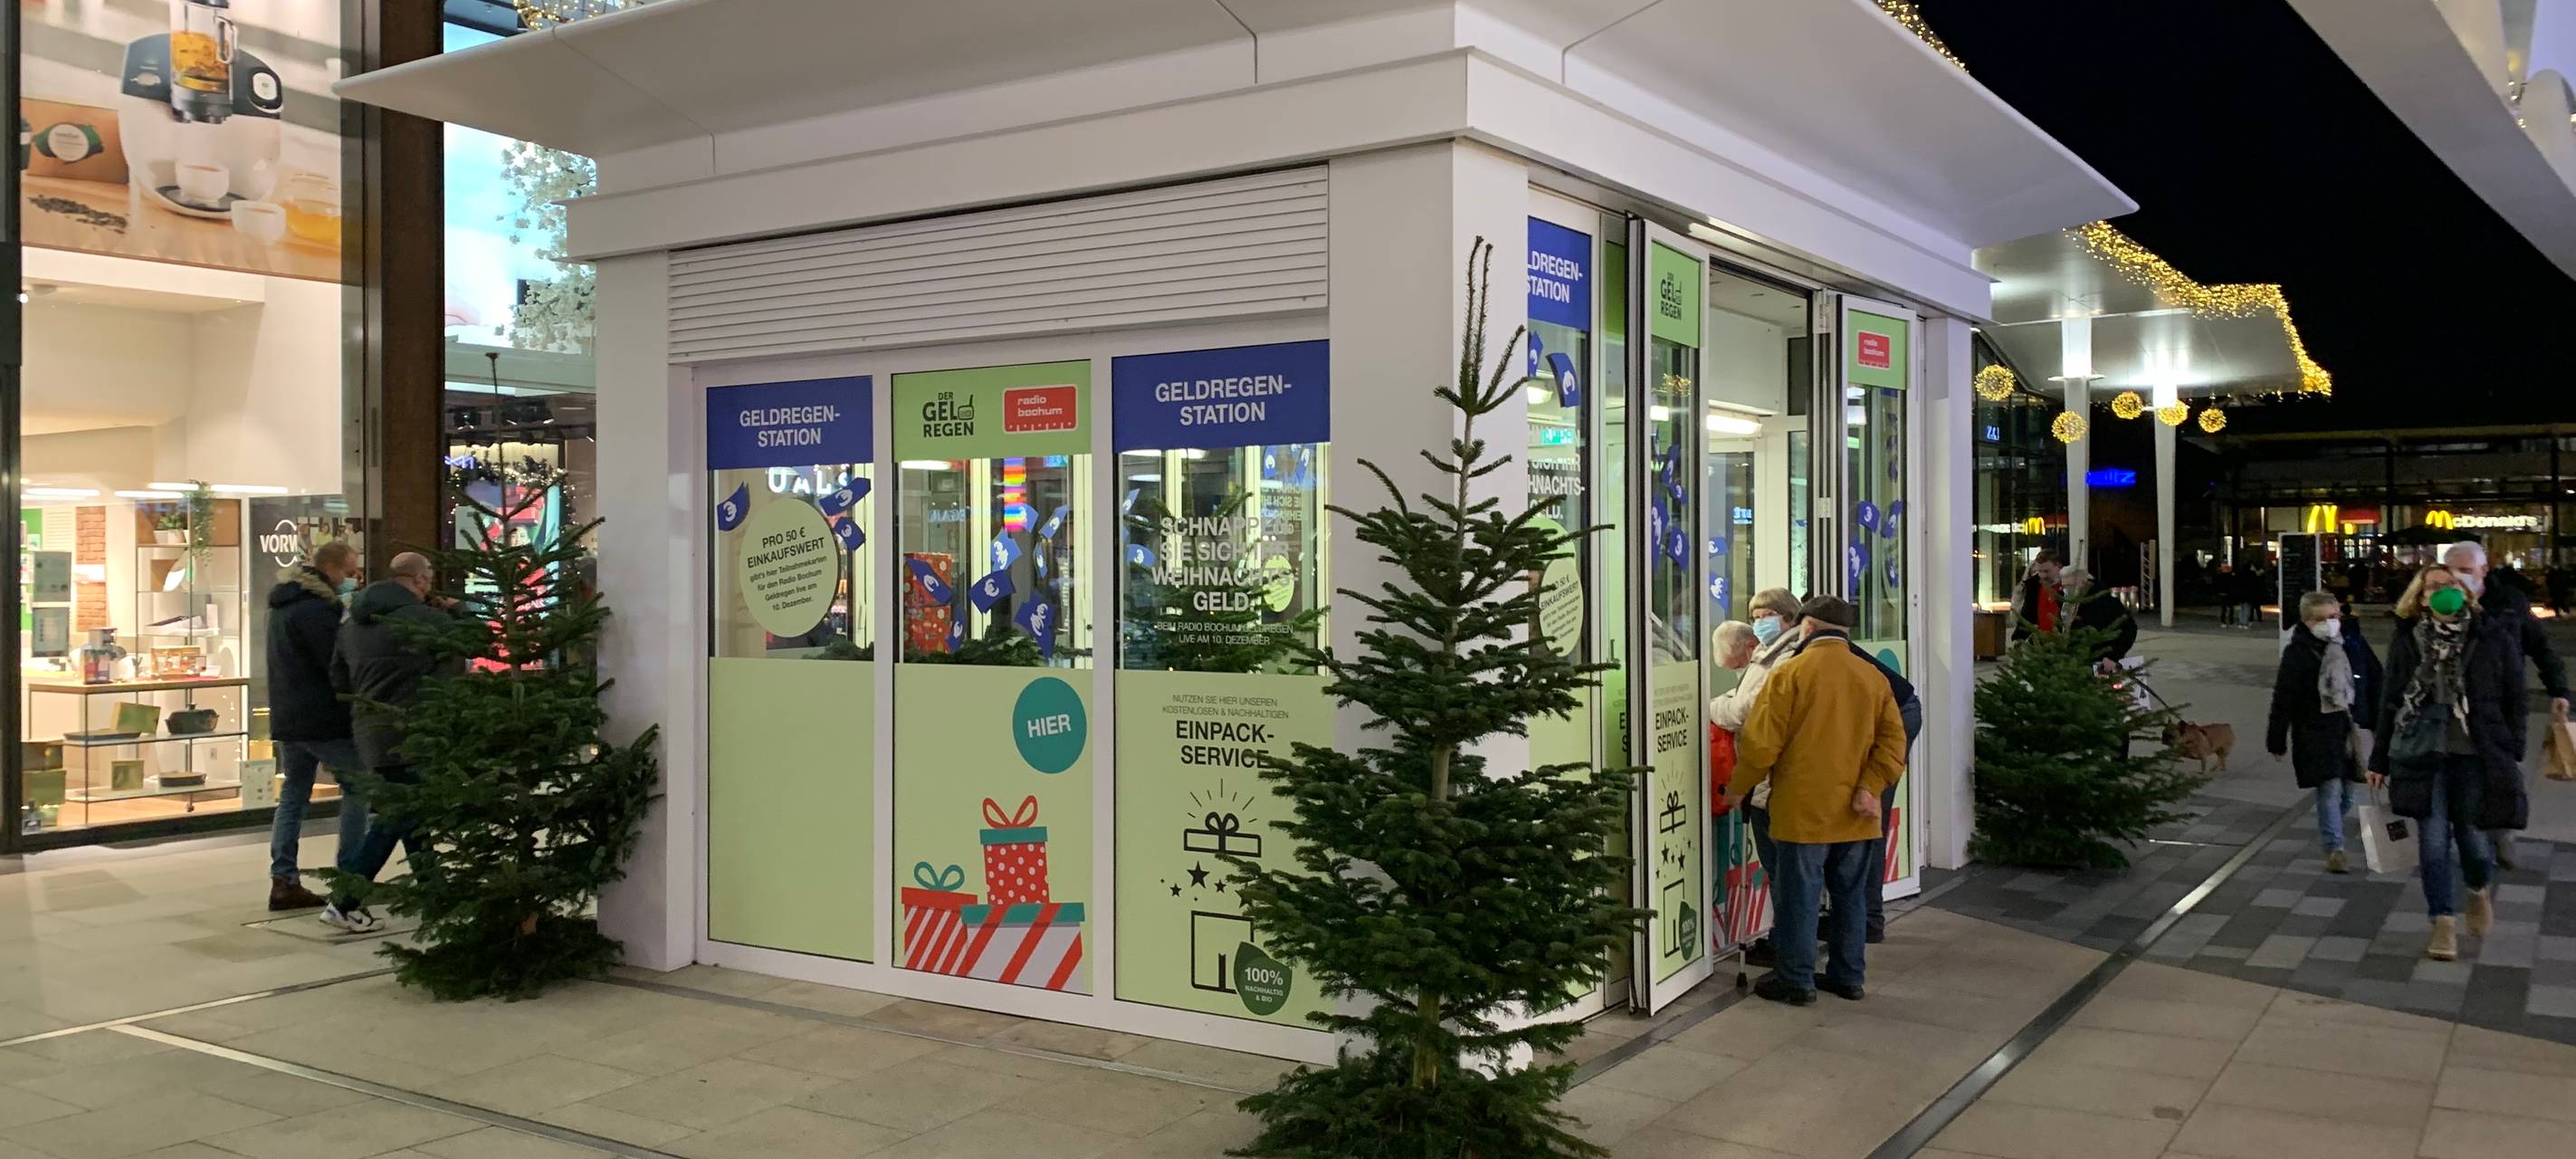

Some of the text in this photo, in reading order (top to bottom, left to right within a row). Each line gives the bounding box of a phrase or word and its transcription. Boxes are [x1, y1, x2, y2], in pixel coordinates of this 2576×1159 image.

[938, 391, 954, 401] DER
[1155, 374, 1293, 403] GELDREGEN-
[1016, 395, 1047, 407] radio
[739, 405, 841, 427] GELDREGEN-
[1017, 407, 1063, 417] bochum
[1179, 401, 1266, 426] STATION
[757, 427, 822, 448] STATION
[922, 422, 975, 438] REGEN
[2425, 510, 2539, 531] McDonald's
[762, 526, 806, 549] PRO 50 €
[747, 537, 825, 569] EINKAUFSWERT
[1159, 541, 1193, 561] SIE
[1197, 541, 1246, 561] SICH
[766, 569, 778, 577] hier
[778, 555, 828, 574] Teilnahmekarten
[757, 569, 823, 591] für den Radio Bochum
[765, 582, 818, 601] Geldregen live am
[1177, 622, 1203, 632] RADIO
[1204, 623, 1243, 633] BOCHUM
[1178, 635, 1271, 646] LIVE AM 10. DEZEMBER
[1173, 694, 1278, 707] NUTZEN SIE HIER UNSEREN
[1162, 705, 1290, 719] KOSTENLOSEN & NACHHALTIGEN
[1655, 706, 1689, 731] EINPACK-
[1027, 714, 1072, 738] HIER
[1176, 720, 1274, 743] EINPACK-
[1657, 728, 1688, 753] SERVICE
[1180, 744, 1270, 769] SERVICE
[1245, 967, 1283, 985] 100%
[1261, 994, 1273, 1003] BIO
